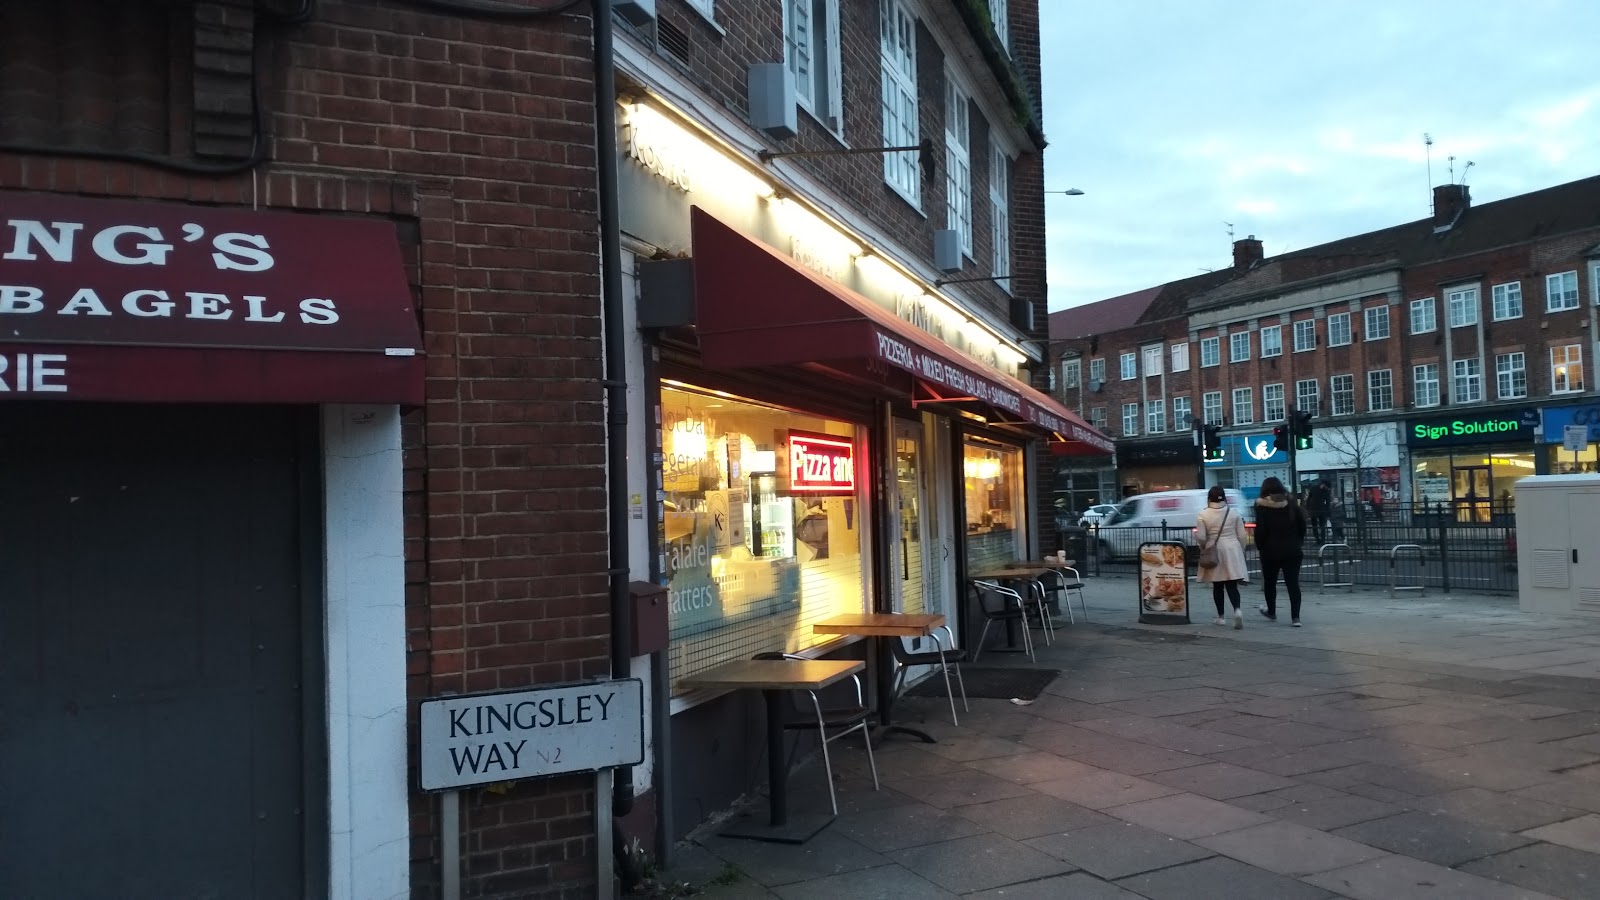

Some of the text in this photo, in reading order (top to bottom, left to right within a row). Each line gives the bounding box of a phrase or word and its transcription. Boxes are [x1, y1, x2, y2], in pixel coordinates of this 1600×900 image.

[3, 219, 276, 272] NG'S
[0, 285, 340, 326] BAGELS
[876, 331, 916, 371] PIZZERIA
[921, 354, 945, 383] MIXED
[944, 365, 966, 392] FRESH
[965, 375, 987, 399] SALADS
[1414, 418, 1519, 440] Sign Solution
[661, 451, 721, 483] egetarian
[791, 444, 832, 482] Pizza
[668, 535, 709, 571] alafel
[668, 582, 713, 614] latters
[449, 692, 615, 738] KINGSLEY
[449, 739, 563, 776] WAY N2
